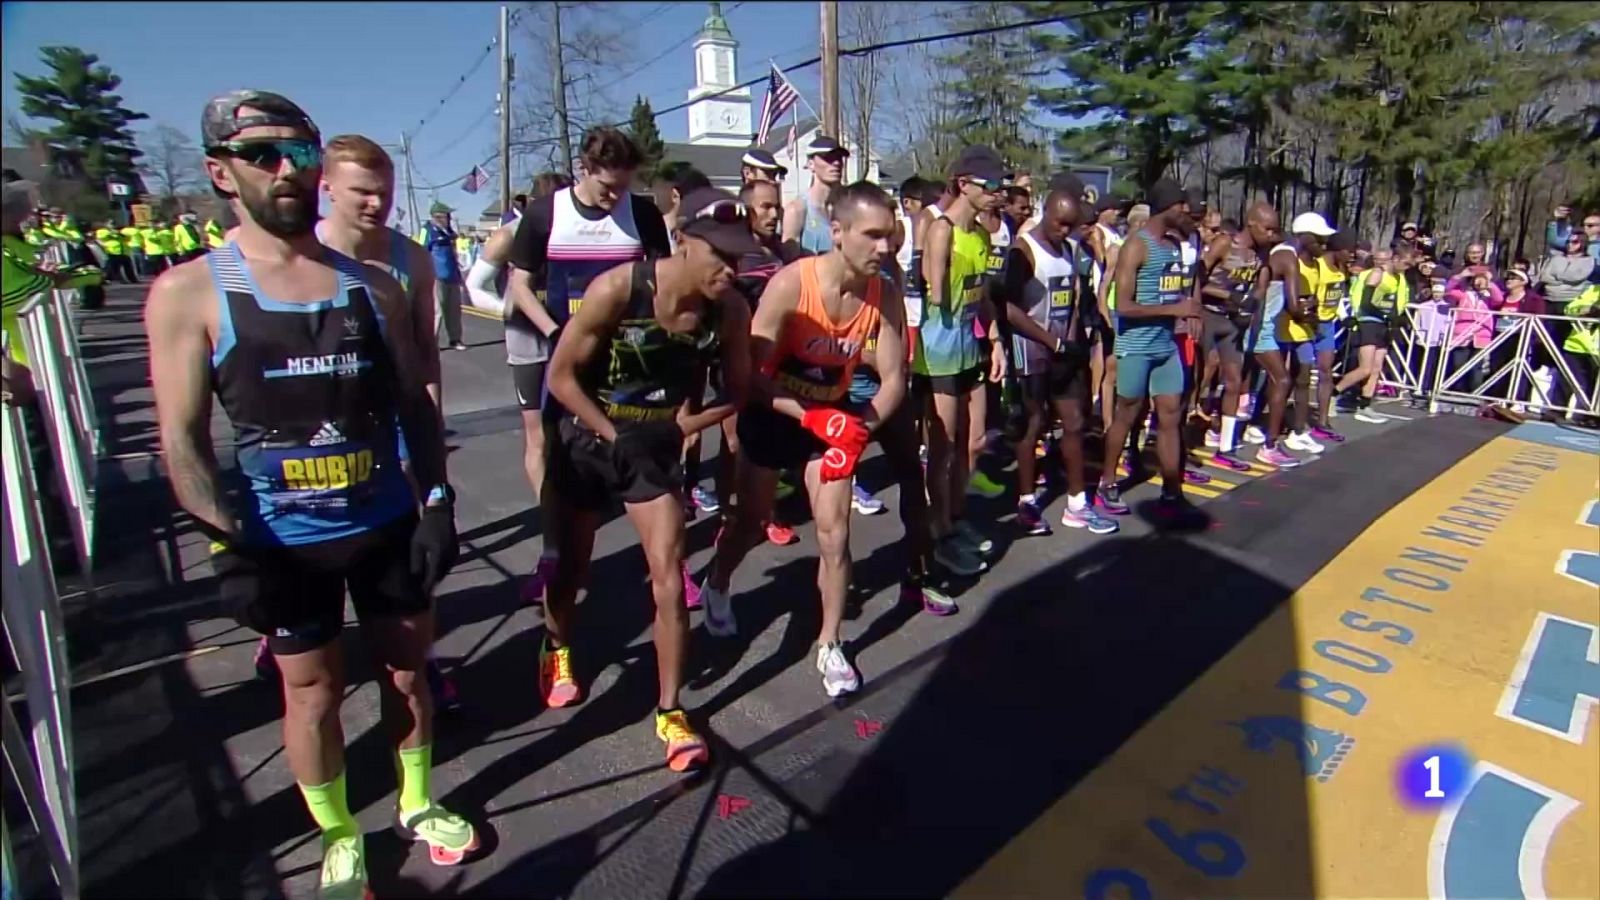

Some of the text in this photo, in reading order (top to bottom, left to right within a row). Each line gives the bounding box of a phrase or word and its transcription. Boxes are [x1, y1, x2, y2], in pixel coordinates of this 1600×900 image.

[282, 450, 374, 490] RUBIO
[1275, 546, 1469, 716] BOSTON
[1420, 467, 1542, 547] MARATHON
